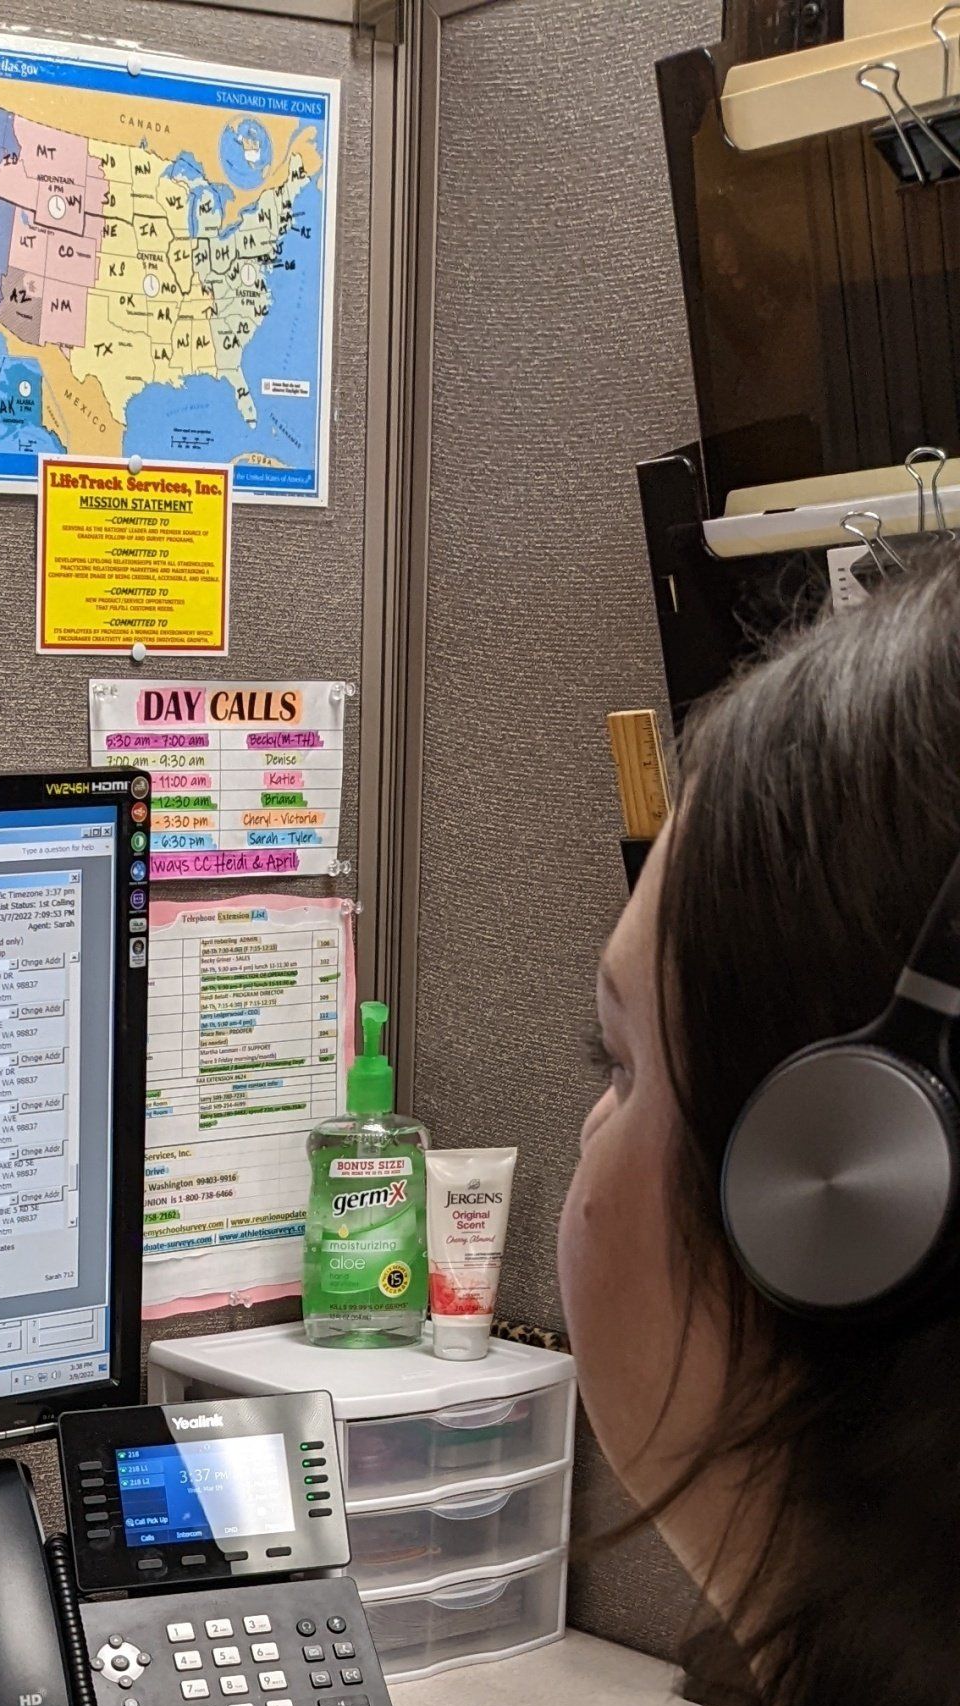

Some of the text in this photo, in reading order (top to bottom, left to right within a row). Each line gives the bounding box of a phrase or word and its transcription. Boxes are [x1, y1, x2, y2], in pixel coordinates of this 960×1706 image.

[217, 92, 322, 115] STANDARD TIME ZONES
[119, 114, 170, 134] CANADA
[36, 144, 56, 160] MT
[101, 156, 116, 167] ND
[135, 164, 151, 174] MN
[37, 174, 74, 184] MOUNTAIN
[166, 196, 184, 209] WI
[258, 209, 272, 228] NY
[103, 224, 117, 238] NE
[140, 222, 157, 236] IA
[20, 236, 36, 248] UT
[243, 235, 256, 247] PA
[59, 245, 74, 257] CO
[137, 252, 163, 262] CENTRAL
[109, 262, 125, 277] KS
[10, 288, 32, 303] AZ
[236, 290, 261, 298] EASTERN
[50, 299, 72, 312] NM
[120, 296, 135, 307] OK
[157, 307, 172, 323] AR
[196, 335, 210, 349] AL
[94, 342, 113, 357] TX
[154, 349, 170, 360] LA
[0, 396, 15, 416] AK
[64, 389, 106, 433] MEXICO
[50, 472, 222, 497] LifeTrack Services, Inc.
[80, 496, 193, 512] MISSION STATEMENT
[144, 690, 297, 721] DAY CALLS
[107, 734, 205, 747] 5:30 am 7:00 am
[106, 754, 205, 767] 7:00 am 9:30 am
[265, 753, 297, 765] Denise
[159, 776, 207, 787] 11:00 am
[269, 773, 295, 785] Katie
[46, 781, 128, 796] VW246H HDMI
[159, 795, 210, 808] 12:30 am
[265, 792, 296, 805] Briana
[163, 816, 209, 829] 3:30 pm
[243, 812, 318, 826] Cheryl Victoria
[161, 836, 205, 849] 6:30 pm
[249, 832, 313, 844] Sarah Tyler
[150, 852, 297, 872] lways CC Heidi & April
[182, 910, 266, 923] Telephone Extension List
[337, 1159, 405, 1170] BONUS SIZE!
[145, 1167, 165, 1176] Drive
[149, 1174, 237, 1192] Washington 99403-9916
[179, 1190, 233, 1202] 1-800-738-6466
[333, 1181, 406, 1216] germ-X
[445, 1191, 503, 1208] JERGENS
[453, 1210, 490, 1220] Original
[457, 1221, 485, 1230] Scent
[330, 1240, 397, 1250] moisturizing
[330, 1256, 366, 1270] aloe
[172, 1414, 223, 1430] Yealink
[180, 1469, 228, 1484] 3:37 PM
[177, 1530, 202, 1538] Intercom
[19, 1694, 42, 1706] HD
